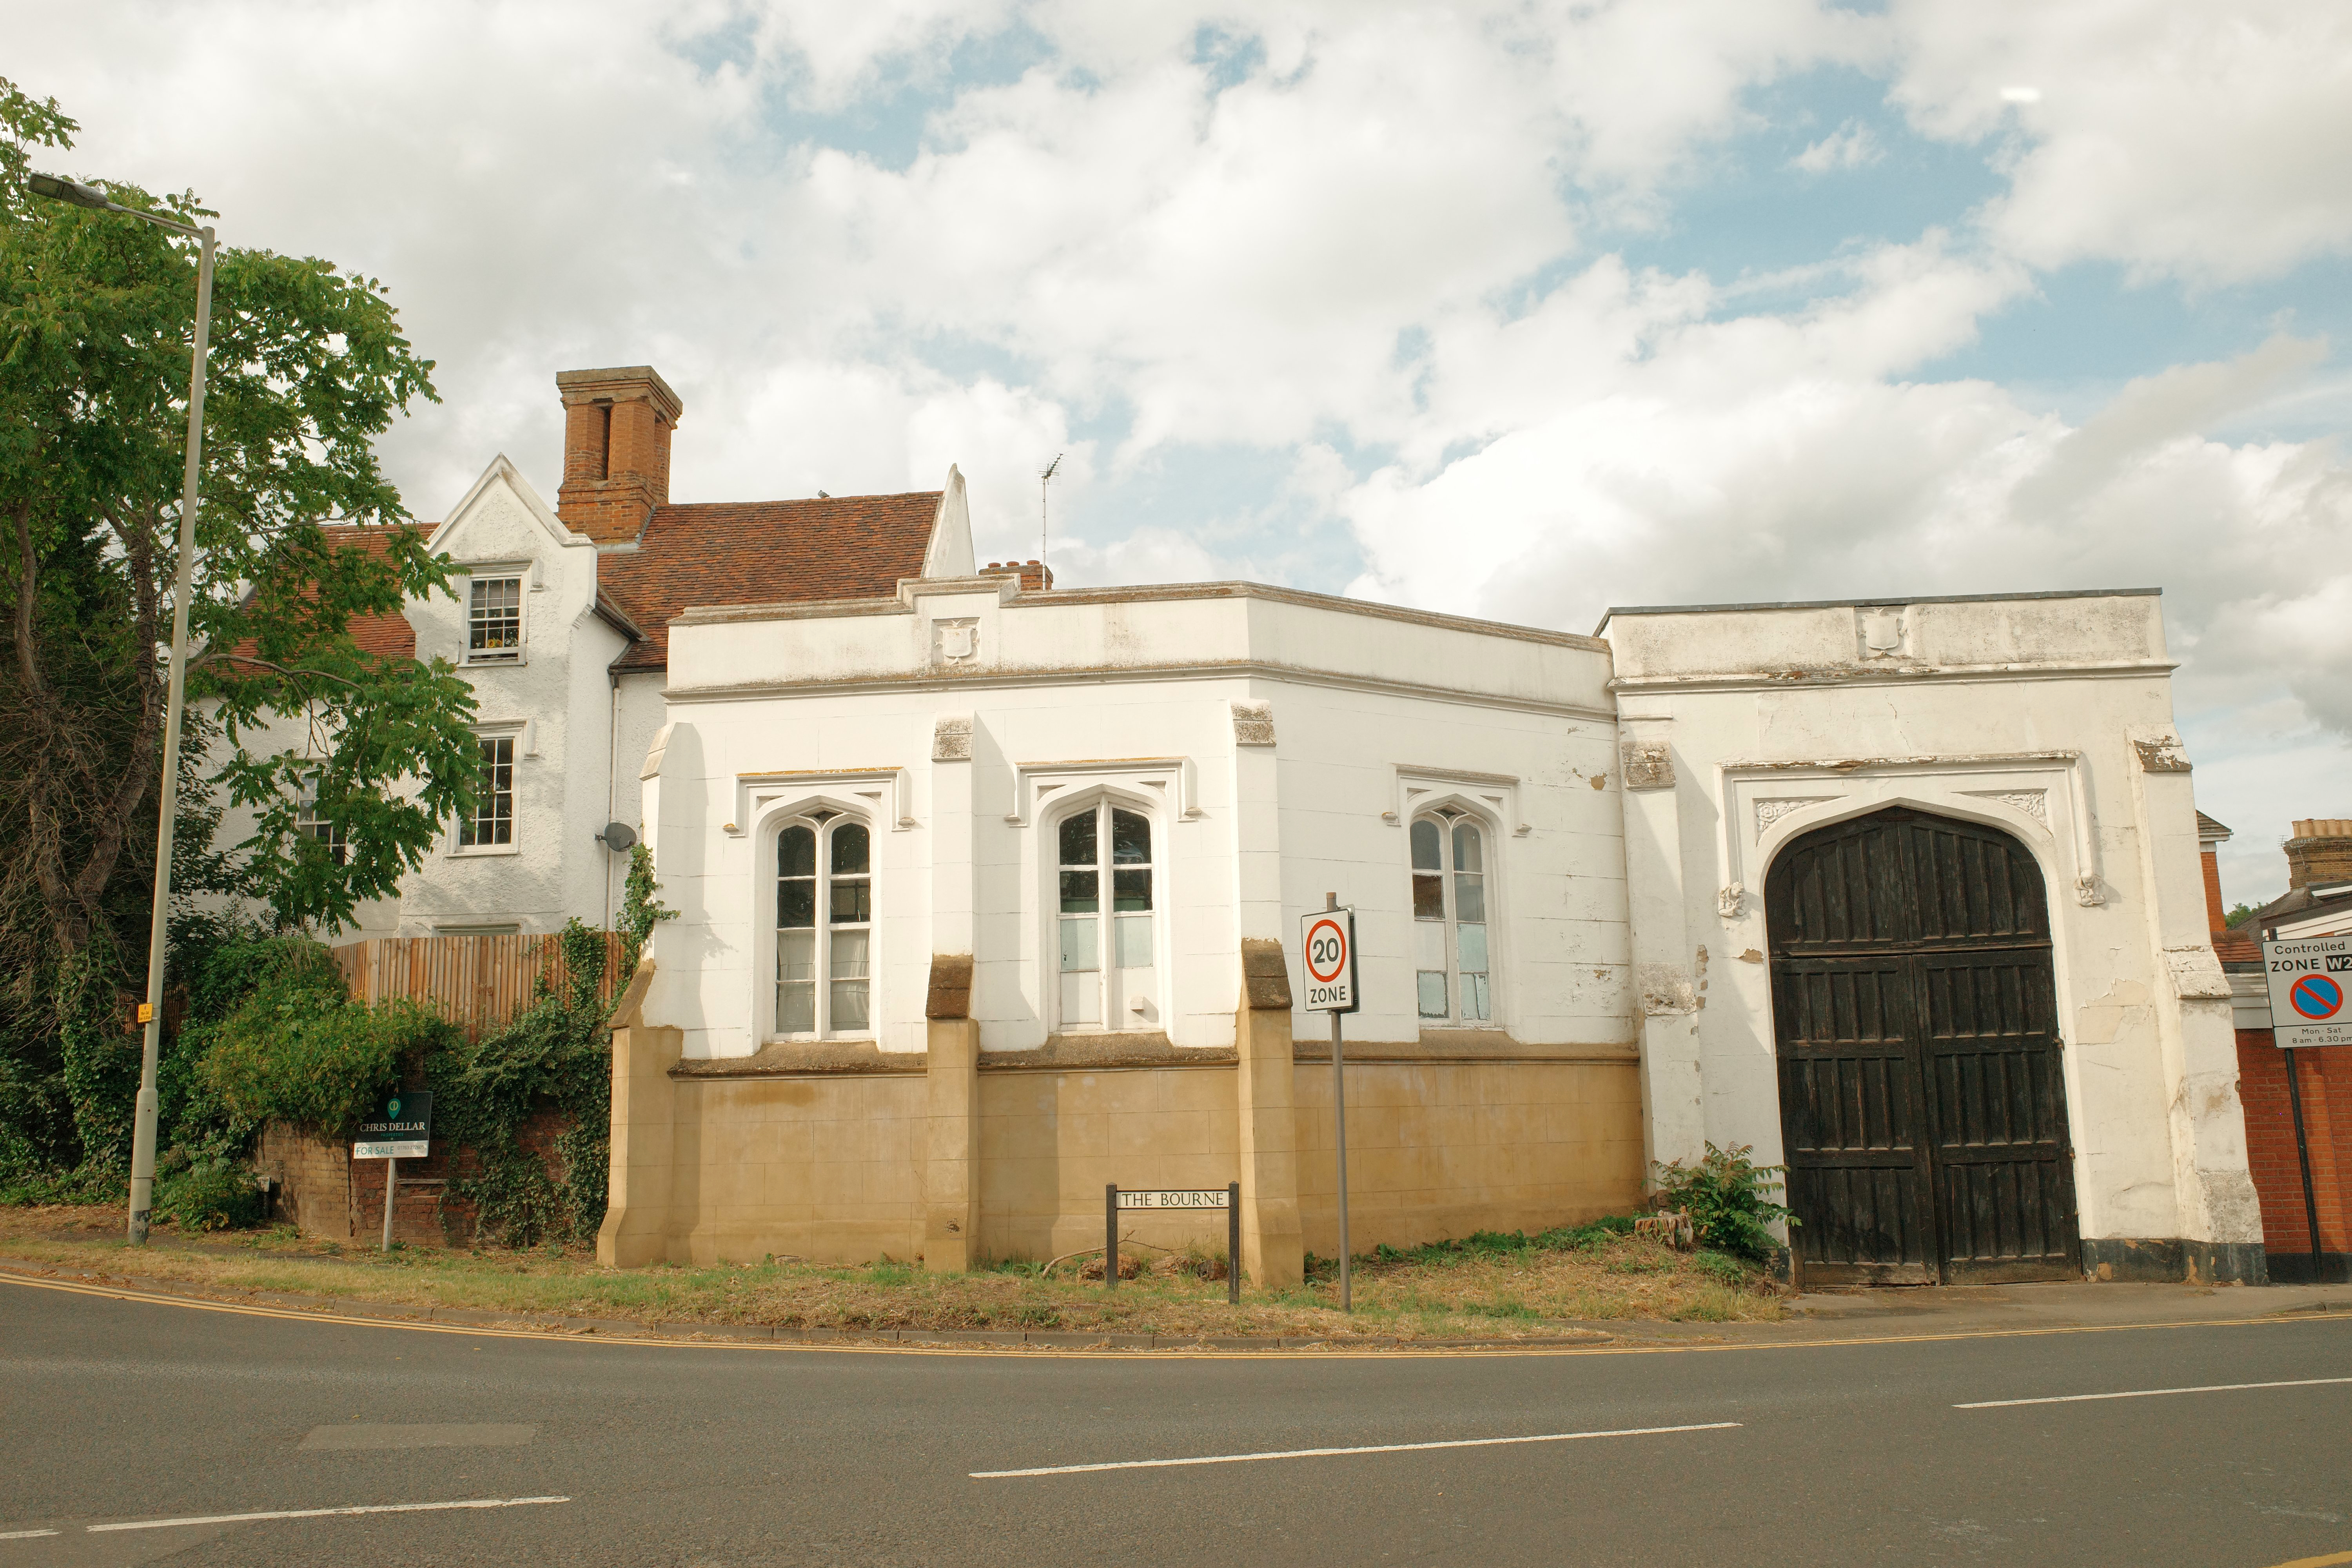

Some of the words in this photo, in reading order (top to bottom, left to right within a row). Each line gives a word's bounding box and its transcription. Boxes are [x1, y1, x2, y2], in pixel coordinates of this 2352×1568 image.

[1313, 937, 1339, 964] 20
[2274, 941, 2345, 955] Controlled
[2270, 958, 2320, 972] ZONE
[2327, 956, 2352, 970] W2
[1310, 985, 1346, 1004] ZONE
[360, 1123, 387, 1132] CHRIS
[388, 1122, 425, 1131] DELLAR
[375, 1146, 394, 1154] SALE
[1122, 1193, 1152, 1206] THE
[1160, 1192, 1224, 1206] BOURNE
